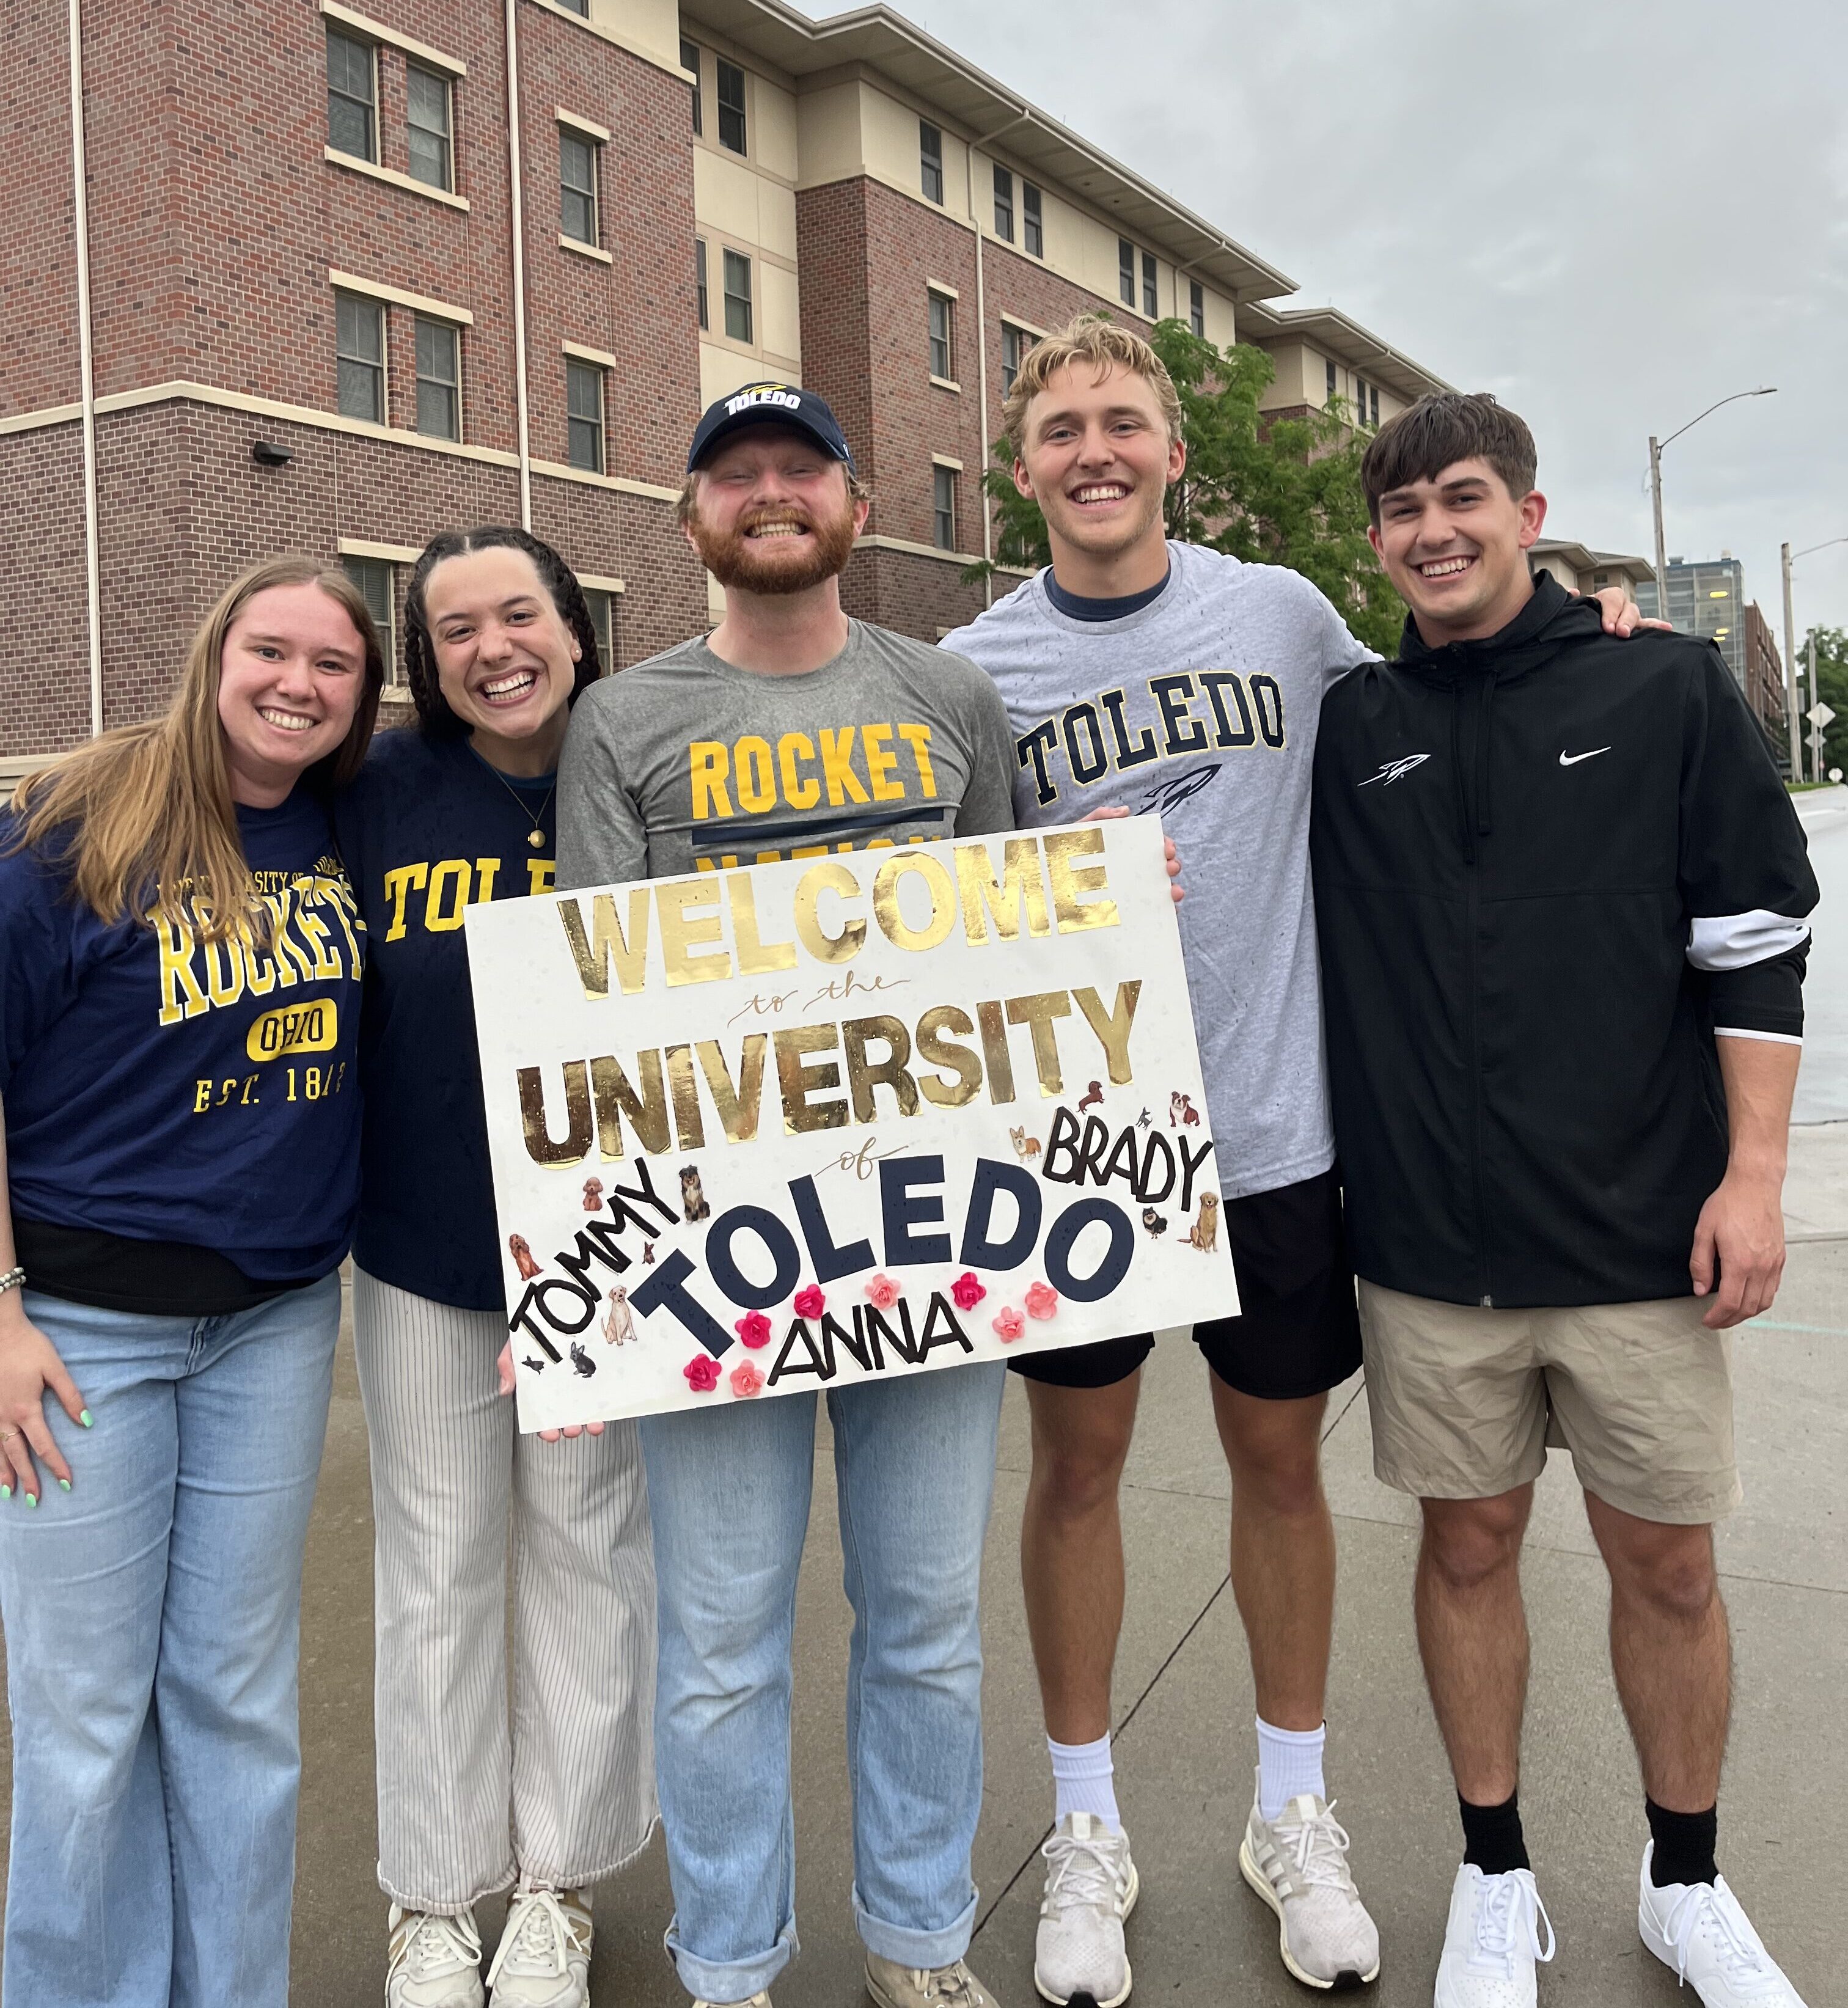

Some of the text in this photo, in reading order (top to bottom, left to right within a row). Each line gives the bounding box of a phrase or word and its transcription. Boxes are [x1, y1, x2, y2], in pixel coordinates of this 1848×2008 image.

[724, 390, 801, 416] TOLEDO
[690, 723, 938, 820] ROCKET
[1017, 671, 1285, 807] TOLEDO
[145, 875, 367, 1025] ROCKET
[557, 827, 1122, 1001] WELCOME
[260, 1008, 323, 1051] OHIO
[728, 971, 911, 1027] to the
[515, 979, 1143, 1171] UNIVERSITY
[815, 1137, 908, 1179] of
[1043, 1106, 1213, 1212] BRADY
[509, 1157, 680, 1363] TOMMY
[627, 1154, 1135, 1358] TOLEDO
[767, 1291, 974, 1386] ANNA
